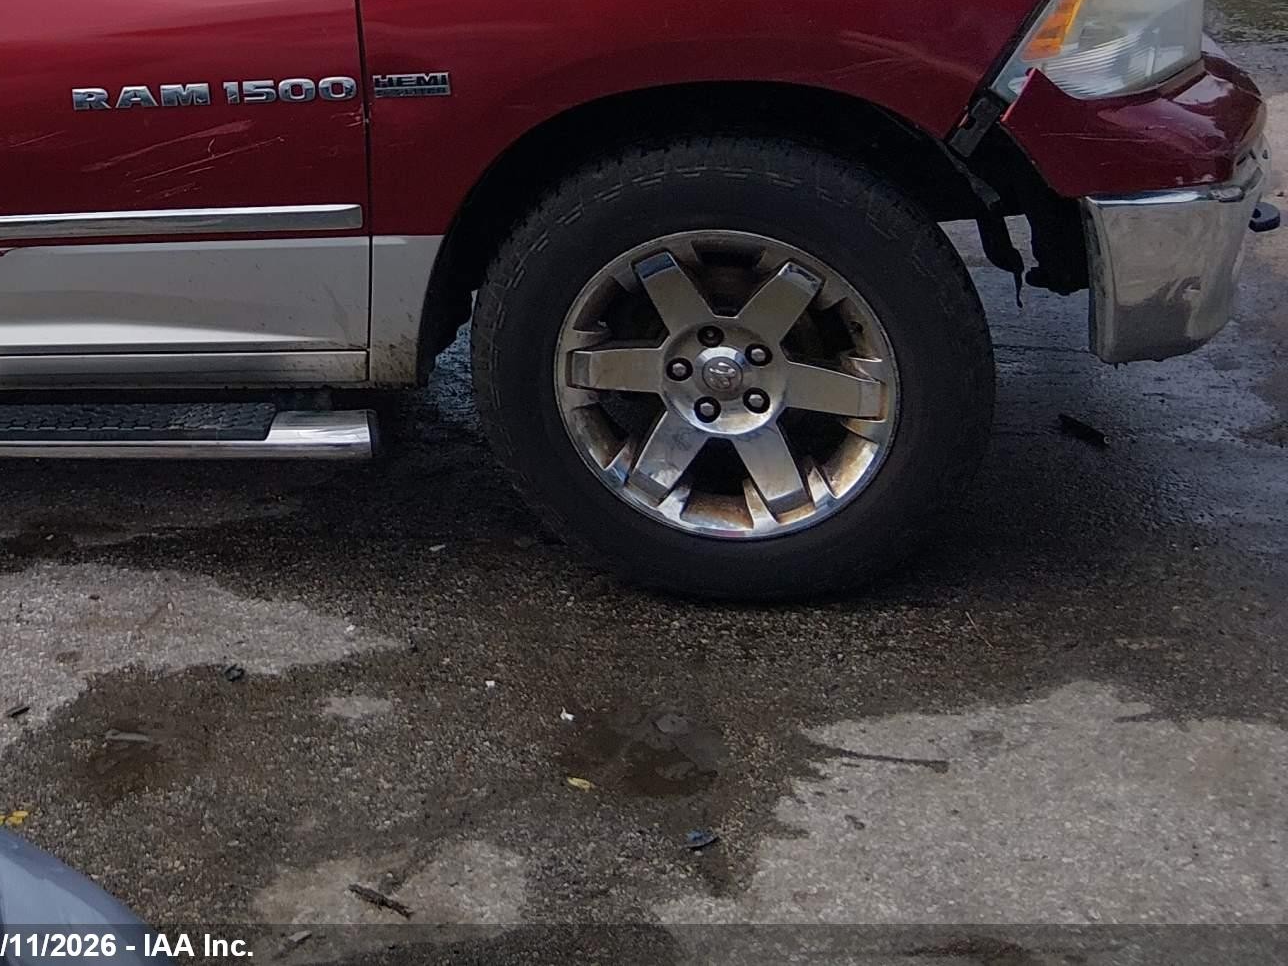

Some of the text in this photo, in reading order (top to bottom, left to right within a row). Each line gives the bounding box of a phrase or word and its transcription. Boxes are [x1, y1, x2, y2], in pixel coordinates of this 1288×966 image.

[72, 76, 357, 111] RAM 1500
[373, 73, 449, 89] HEMI
